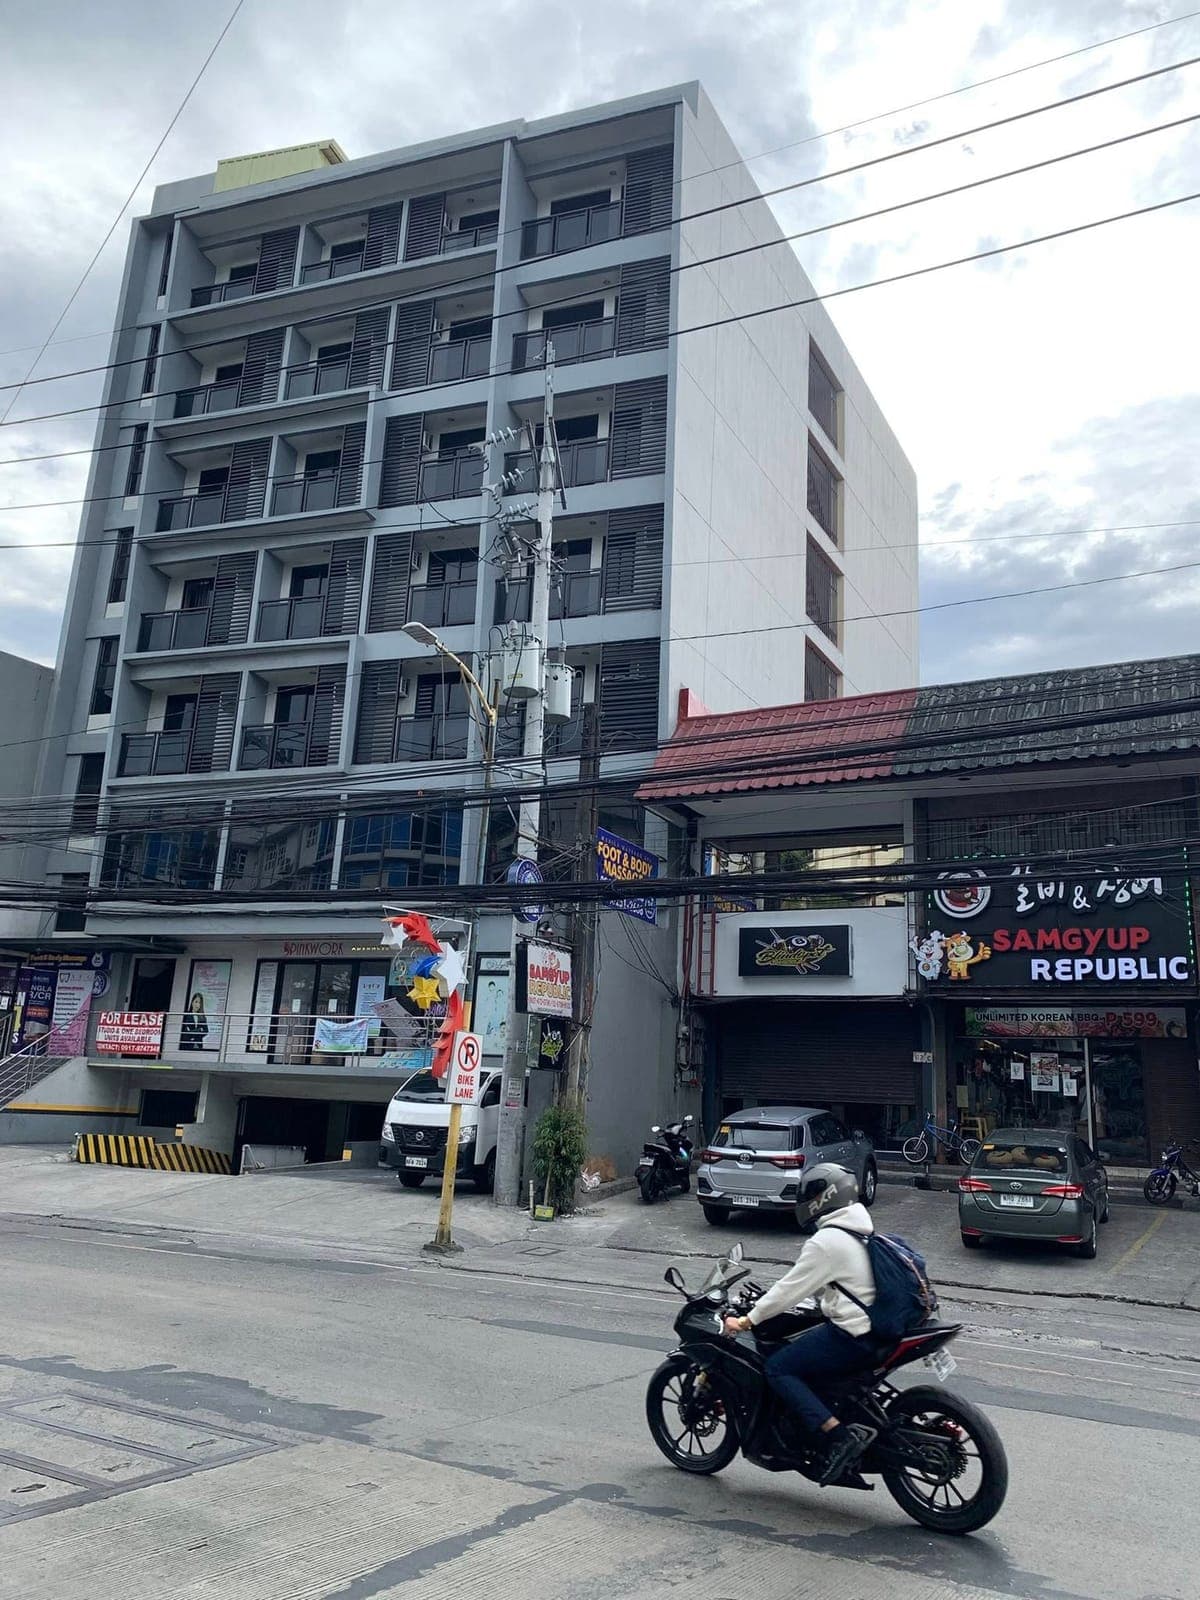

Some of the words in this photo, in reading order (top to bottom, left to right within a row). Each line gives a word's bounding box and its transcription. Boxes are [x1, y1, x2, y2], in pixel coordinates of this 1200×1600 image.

[597, 841, 621, 864] FOOT
[622, 852, 630, 869] &
[631, 855, 653, 877] BODY
[1072, 885, 1092, 909] &
[993, 927, 1150, 955] SAMGYUP
[1031, 956, 1189, 981] REPUBLIC
[101, 1012, 120, 1024] FOR
[124, 1013, 163, 1025] LEASE
[976, 1013, 1029, 1022] UNLIMITED
[1031, 1013, 1074, 1022] KOREAN
[457, 1074, 475, 1086] BIKE
[454, 1087, 474, 1099] LANE
